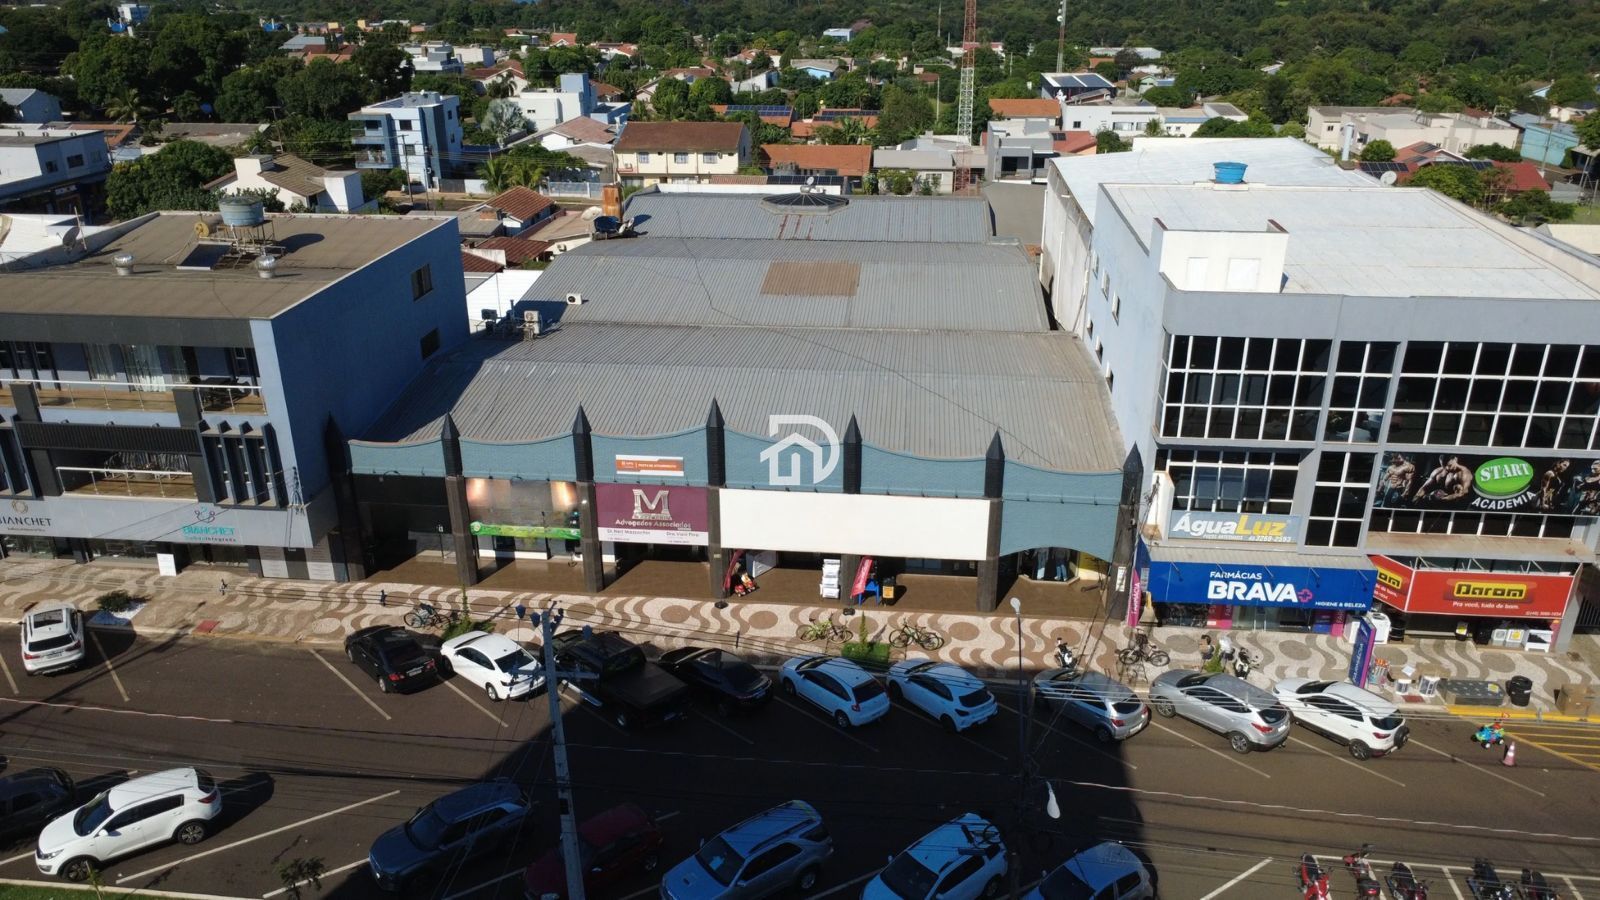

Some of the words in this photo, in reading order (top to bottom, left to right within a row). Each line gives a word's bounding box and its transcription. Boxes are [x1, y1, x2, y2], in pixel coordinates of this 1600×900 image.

[1480, 463, 1530, 482] START
[1472, 491, 1536, 510] ACADEMIA
[1172, 512, 1288, 537] ÁguaLuz
[1209, 570, 1263, 580] FARMÁCIAS
[1207, 580, 1299, 603] BRAVA
